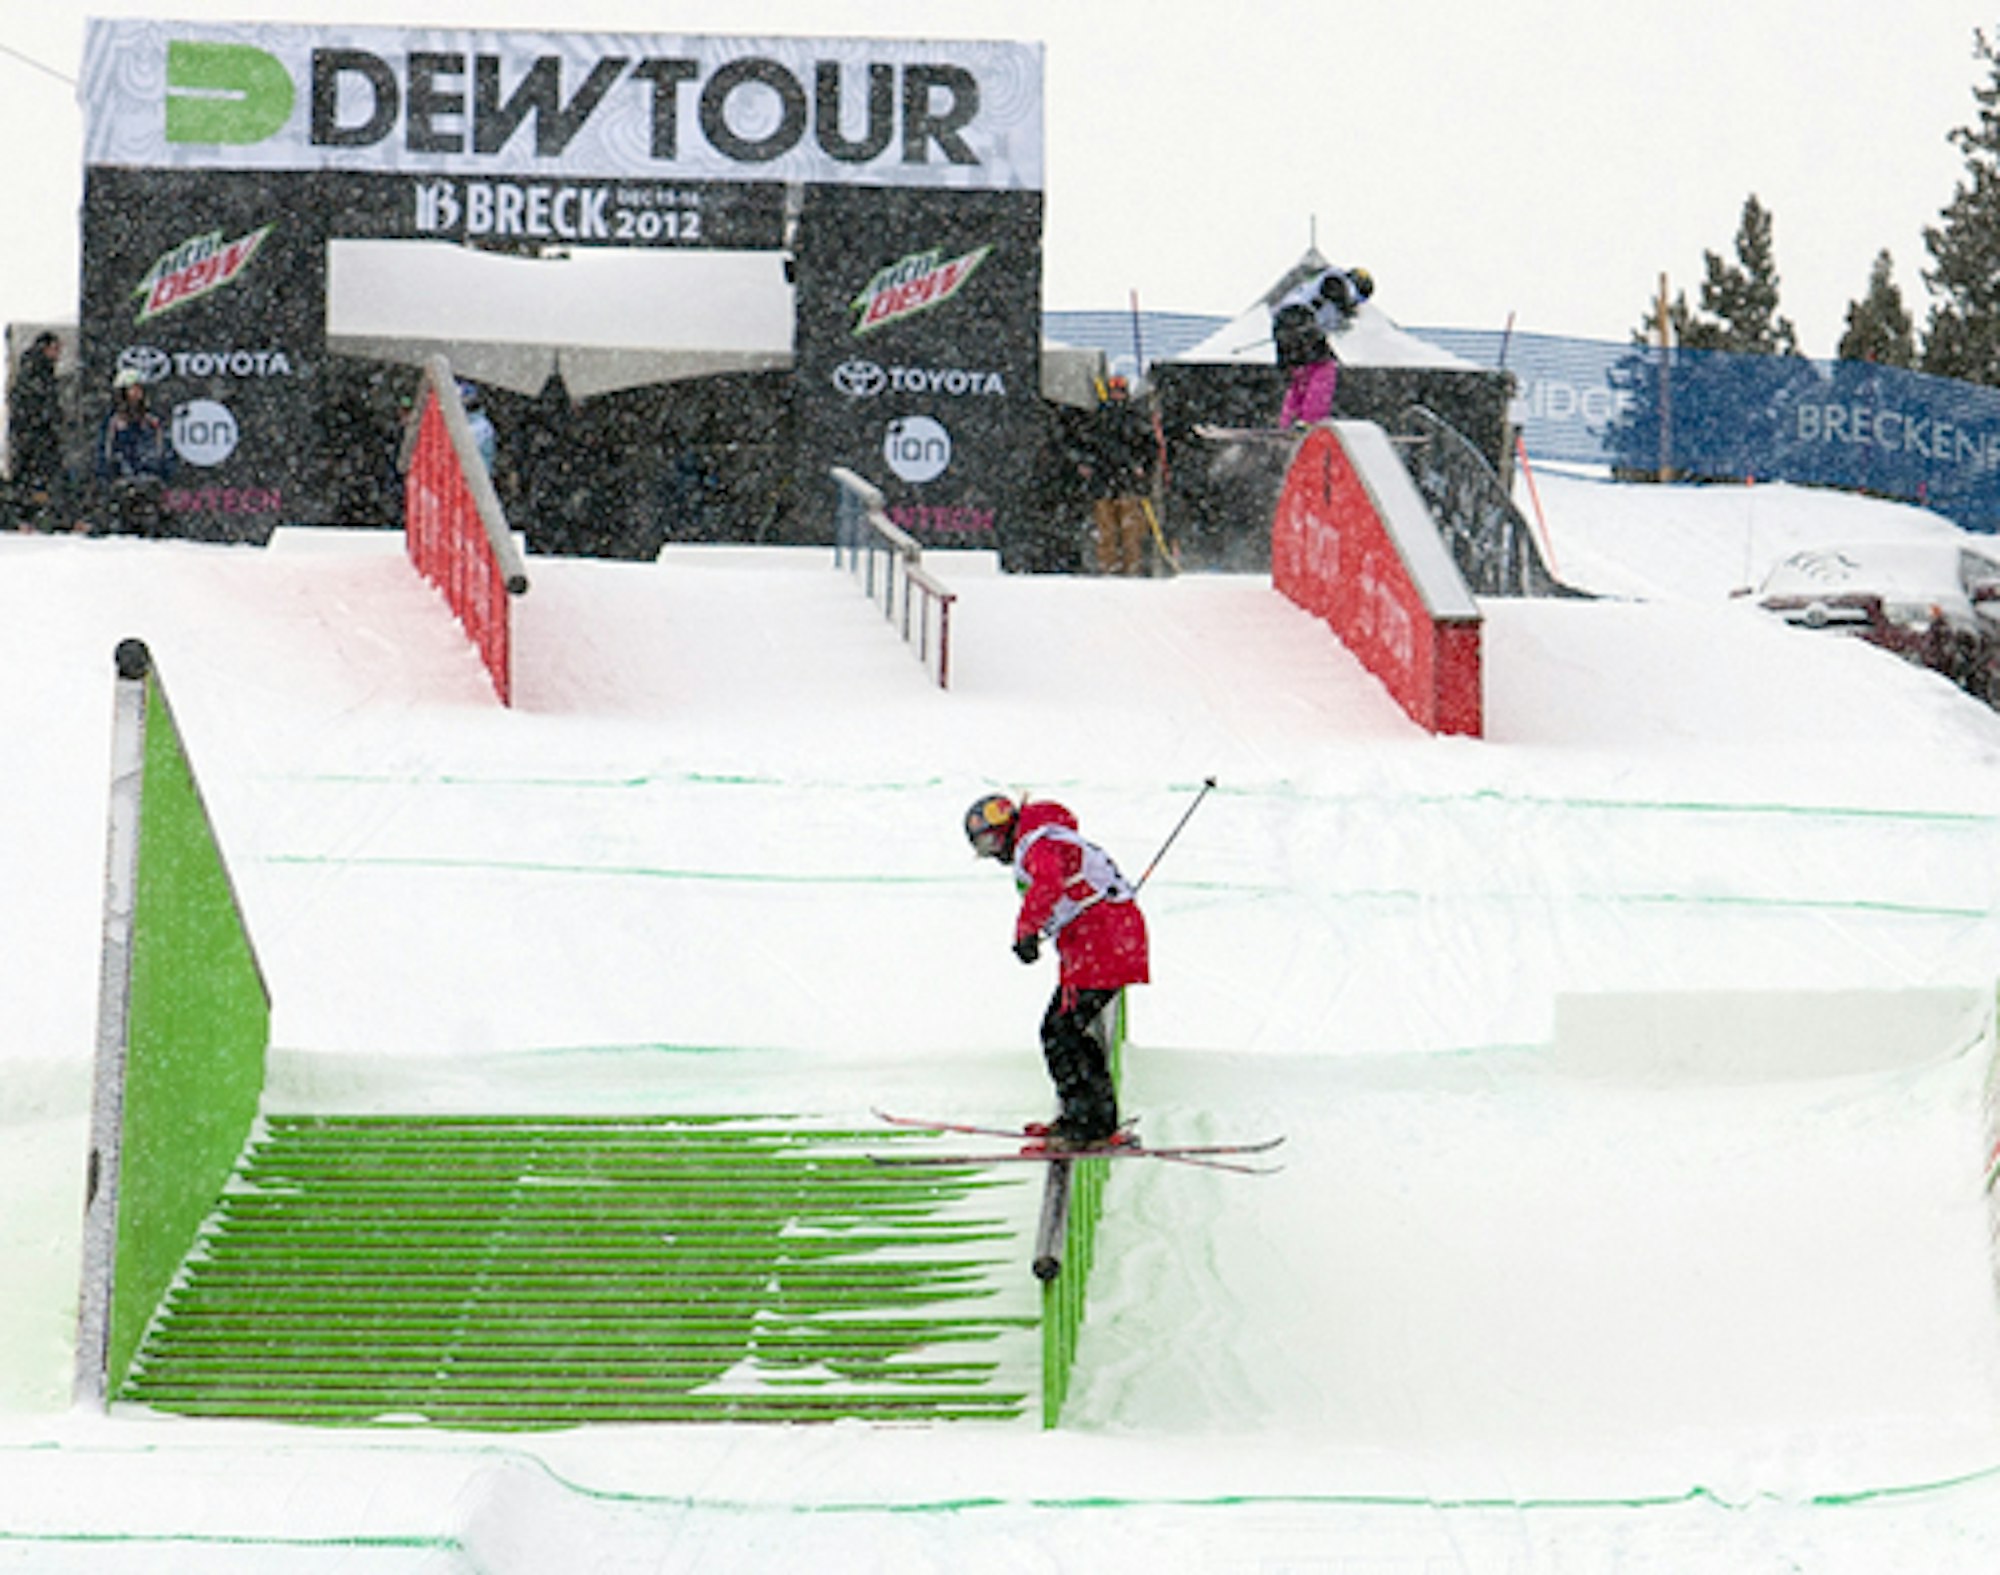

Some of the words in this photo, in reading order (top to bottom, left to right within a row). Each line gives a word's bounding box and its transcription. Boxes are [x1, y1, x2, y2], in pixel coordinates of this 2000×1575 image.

[466, 182, 609, 240] BRECK
[615, 209, 700, 239] 2012
[172, 352, 293, 377] TOYOTA
[888, 369, 1006, 395] TOYOTA
[179, 405, 232, 446] ion
[892, 421, 946, 462] ion
